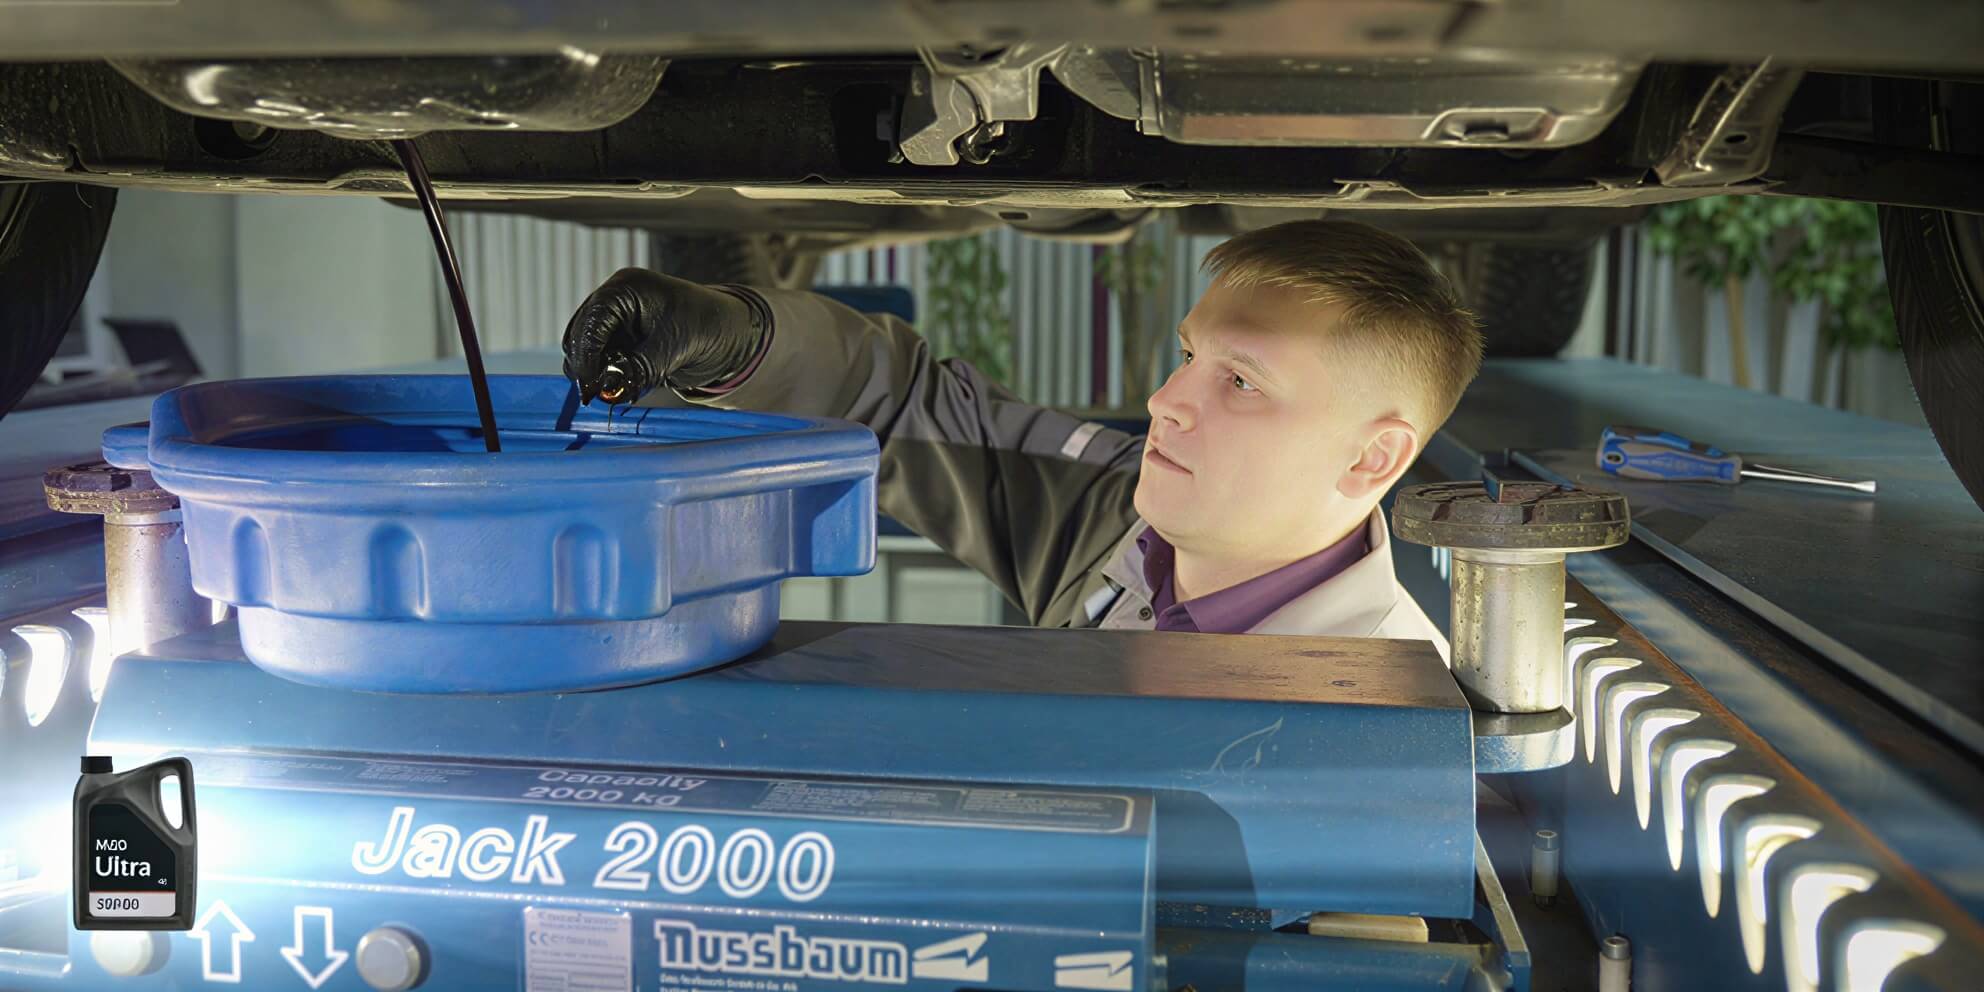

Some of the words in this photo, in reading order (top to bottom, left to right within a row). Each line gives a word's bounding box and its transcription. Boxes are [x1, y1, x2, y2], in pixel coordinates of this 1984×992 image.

[522, 786, 624, 802] 2000
[351, 806, 577, 886] Jack
[593, 820, 836, 902] 2000
[95, 855, 151, 877] Ultra
